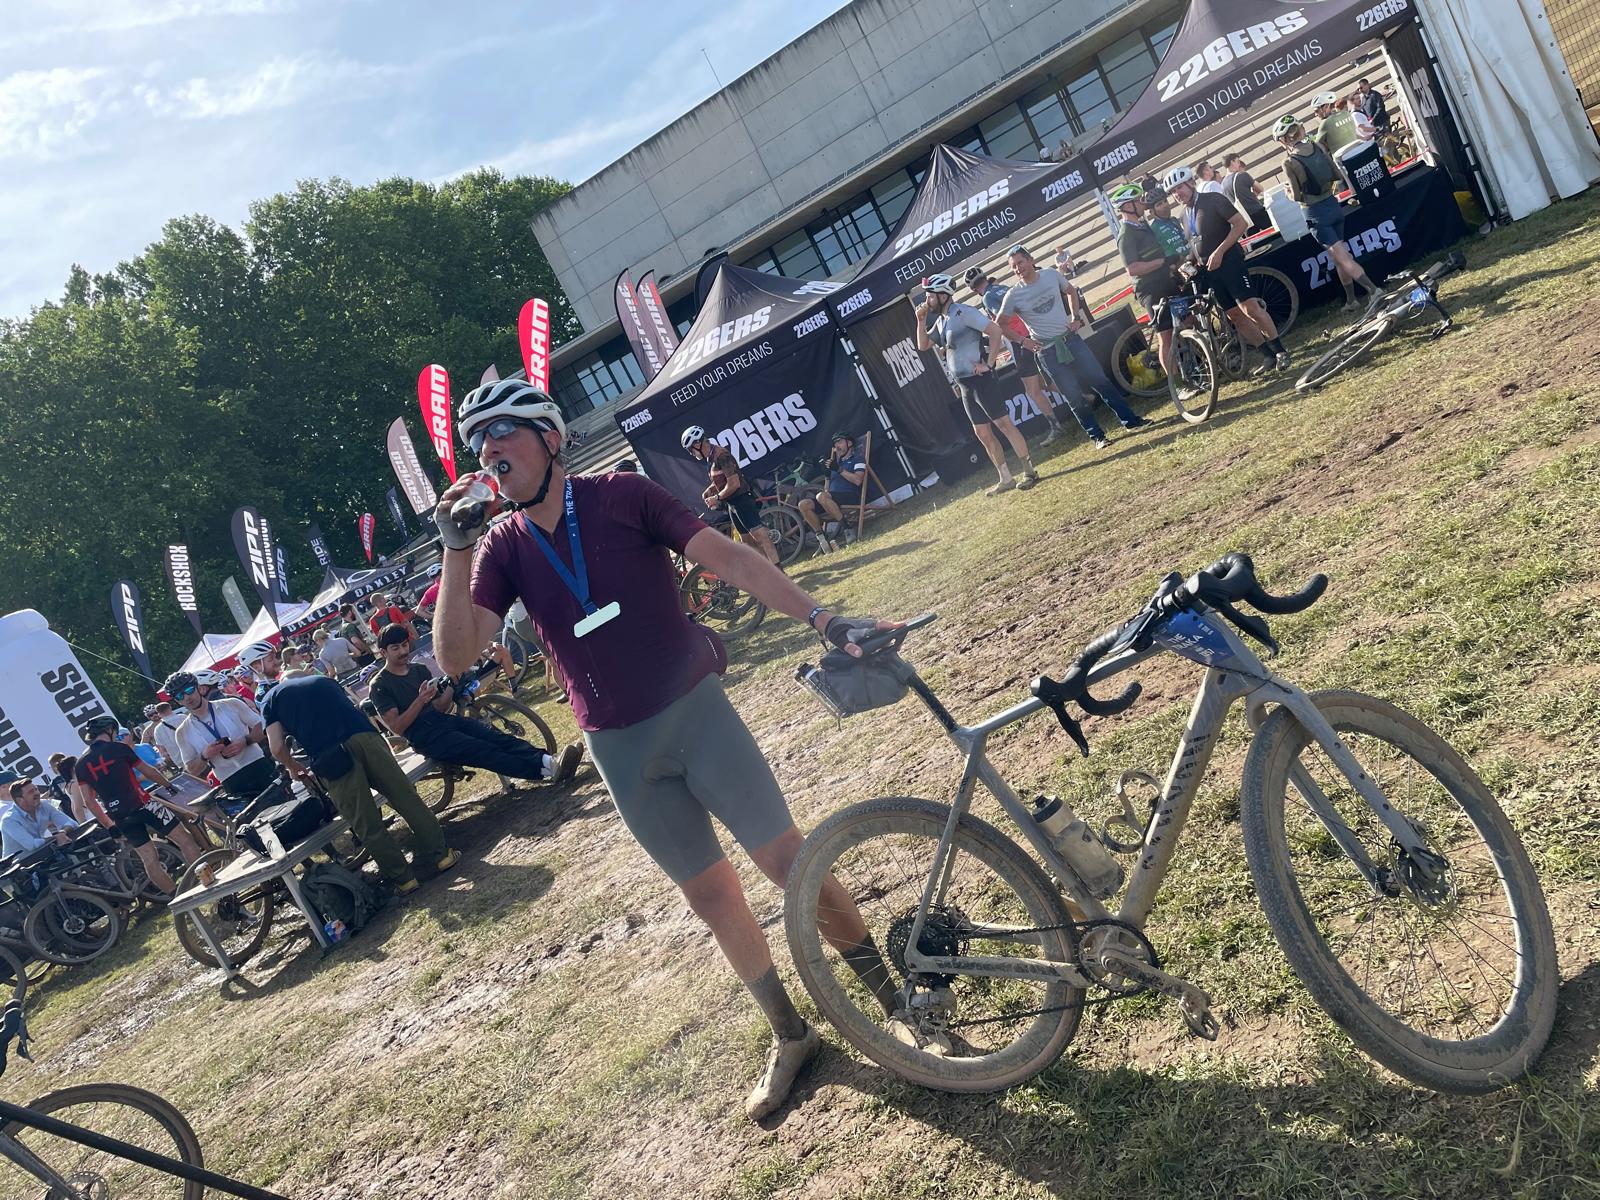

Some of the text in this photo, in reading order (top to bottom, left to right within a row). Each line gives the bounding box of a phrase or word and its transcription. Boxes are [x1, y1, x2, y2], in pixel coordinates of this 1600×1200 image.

[1356, 0, 1408, 31] 226ERS
[1157, 10, 1308, 102] 226ERS
[1168, 102, 1207, 134] FEED
[1207, 78, 1252, 110] YOUR
[1253, 39, 1322, 86] DREAMS
[1093, 141, 1138, 175] 226ERS
[1353, 158, 1380, 178] 226ERS
[1359, 171, 1384, 190] DREAMS
[1041, 170, 1083, 202] 226ERS
[892, 178, 1009, 260] 226ERS
[894, 207, 1016, 284] FEED YOUR DREAMS
[1300, 219, 1402, 290] 22ERS
[793, 310, 829, 339] 226ERS
[837, 288, 873, 318] 226ERS
[670, 305, 771, 379] 226ERS
[670, 342, 773, 407] FEED YOUR DREAMS
[430, 364, 450, 460] SRAM
[621, 409, 652, 433] 226ERS
[708, 393, 818, 469] 26ERS
[566, 501, 574, 516] THE
[243, 510, 269, 589] ZIPP
[276, 547, 289, 596] ZIPP
[310, 538, 328, 566] RIDE
[169, 545, 197, 611] ROCKSHOX
[354, 565, 407, 598] OAKLEY
[121, 583, 144, 654] ZIPP
[287, 597, 341, 633] OAKLEY
